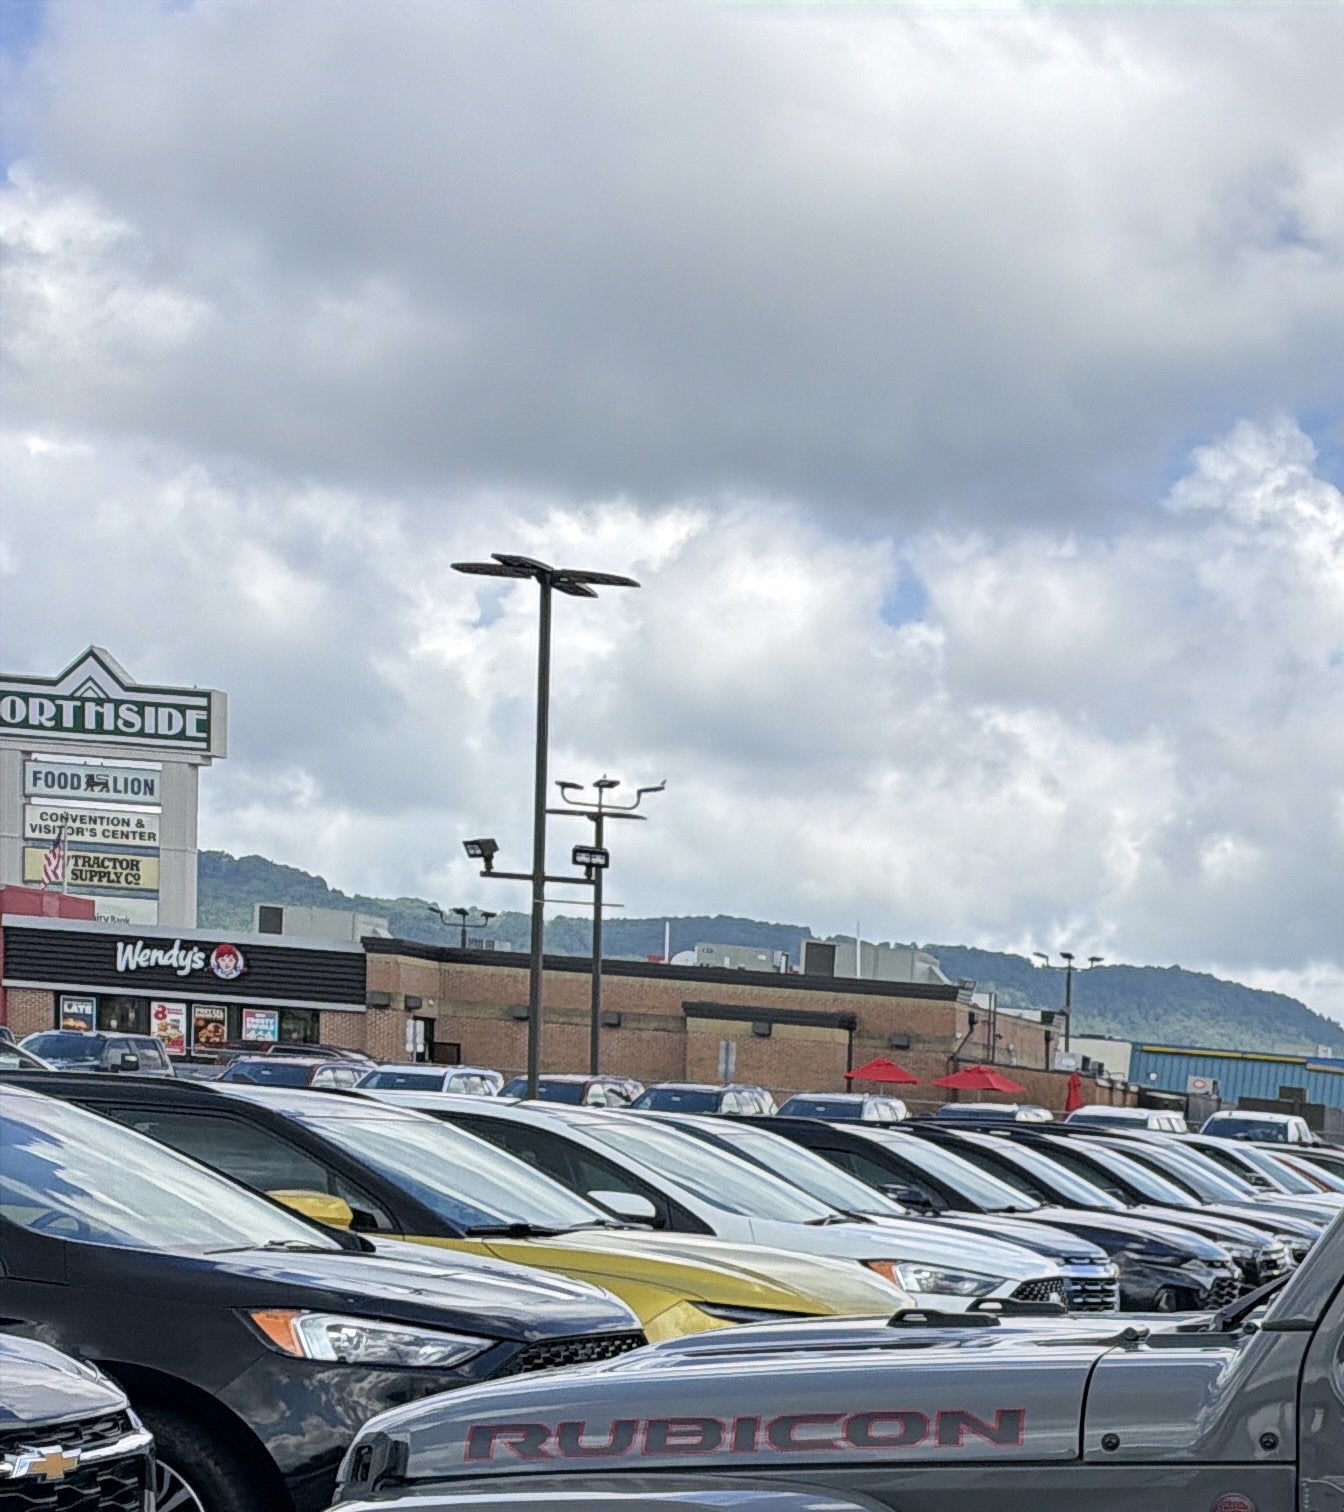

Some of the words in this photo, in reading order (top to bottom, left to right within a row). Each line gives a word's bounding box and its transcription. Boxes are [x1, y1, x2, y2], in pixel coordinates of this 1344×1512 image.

[0, 696, 208, 738] ORTHSIDE
[32, 770, 82, 791] FOOD
[112, 775, 155, 796] LION
[39, 811, 131, 828] CONVENTION
[135, 818, 145, 829] &
[30, 823, 97, 838] VISITOR'S
[101, 829, 157, 842] CENTER
[71, 855, 141, 872] TRACTOR
[71, 869, 121, 885] SUPPLY
[116, 939, 206, 976] Wendy's
[463, 1408, 1026, 1463] RUBICON
